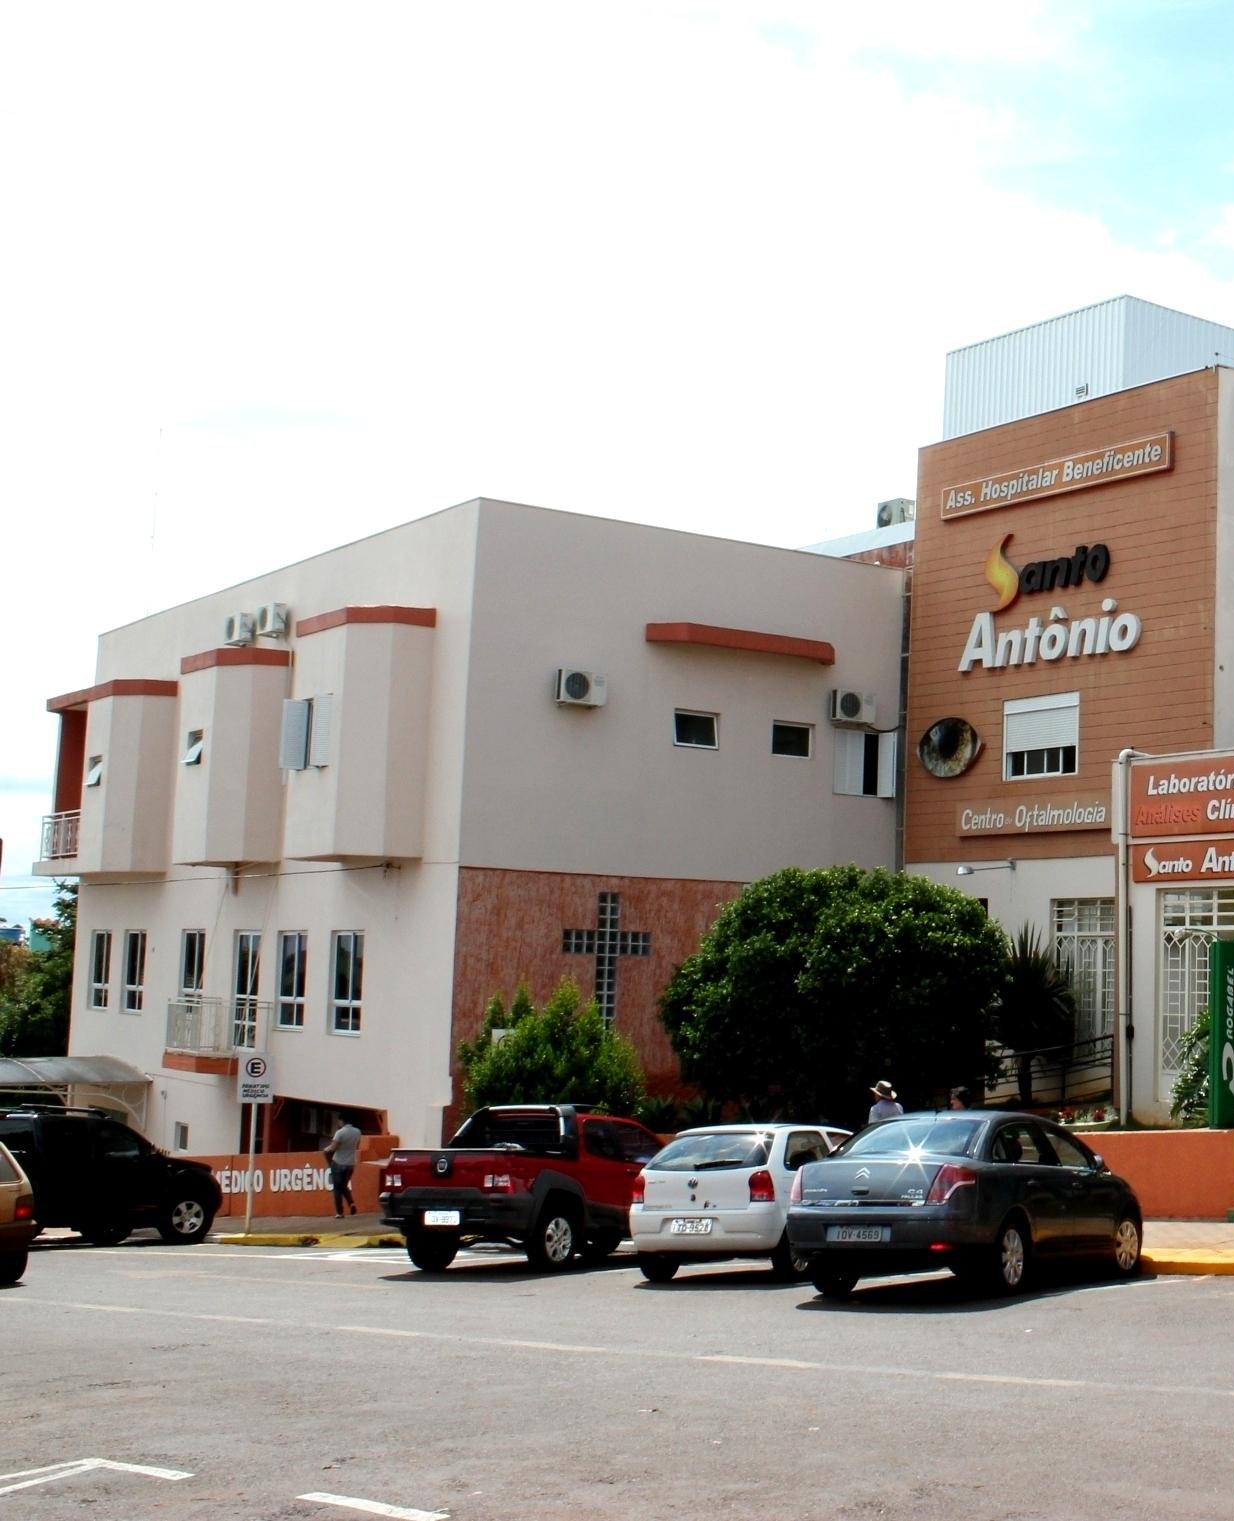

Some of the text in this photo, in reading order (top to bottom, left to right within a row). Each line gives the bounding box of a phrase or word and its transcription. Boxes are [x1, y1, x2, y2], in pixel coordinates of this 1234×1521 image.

[946, 443, 1162, 510] Ass. Hospitalar Beneficente
[984, 533, 1110, 612] Santo
[958, 598, 1142, 673] Antônio
[961, 807, 1005, 831] Centro
[1135, 803, 1201, 826] Análises
[1144, 847, 1193, 878] Santo
[211, 1165, 264, 1193] ÉDICO
